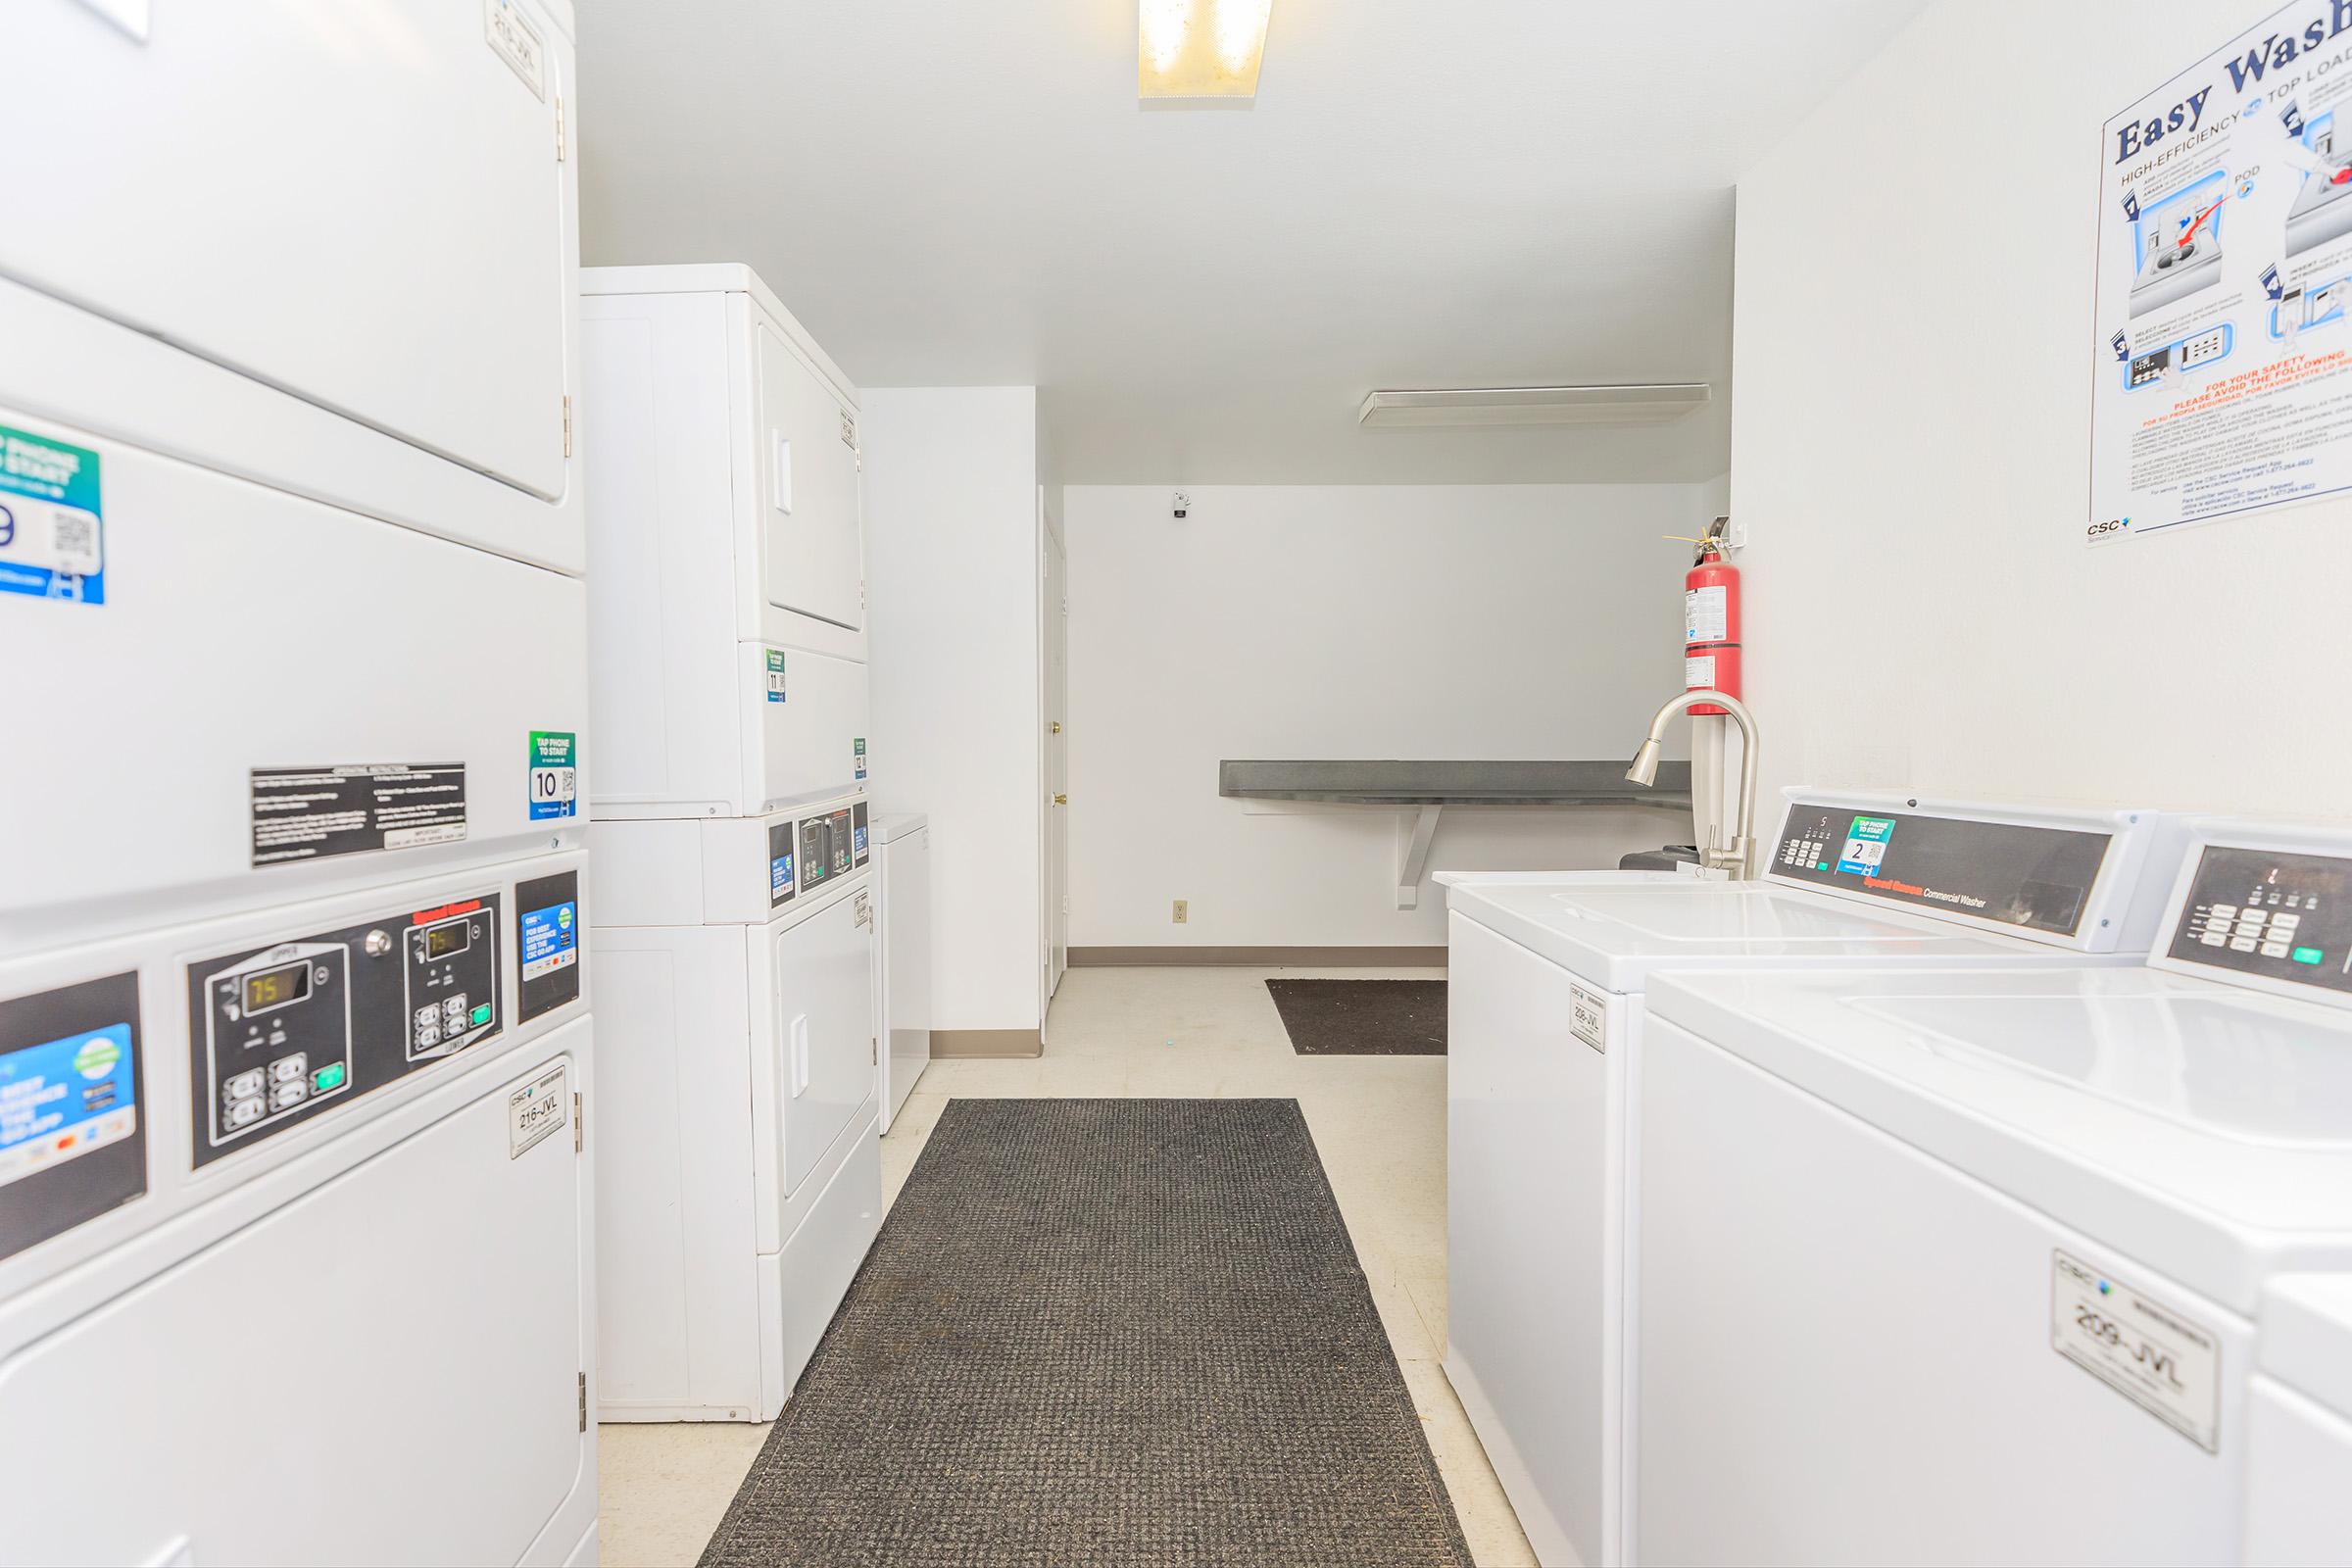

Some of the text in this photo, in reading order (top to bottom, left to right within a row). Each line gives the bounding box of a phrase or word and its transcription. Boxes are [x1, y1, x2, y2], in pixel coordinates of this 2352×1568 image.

[2268, 76, 2300, 103] TOP
[2115, 85, 2212, 165] Easy
[2122, 111, 2239, 186] HIGH-EFFICIENCY
[2234, 165, 2260, 184] POD
[2116, 341, 2127, 355] 3
[2174, 392, 2211, 411] PLEASE
[2214, 380, 2246, 398] AVOID
[2248, 372, 2270, 387] THE
[2275, 348, 2345, 378] FOLLOWING
[2205, 352, 2305, 392] FOR YOUR SAFETY
[2087, 519, 2120, 536] CSC
[537, 737, 570, 748] TAP PHONE
[539, 747, 549, 756] TO
[537, 772, 556, 797] 10
[1852, 843, 1863, 858] 2
[1923, 887, 1961, 903] Commercial
[1960, 894, 1986, 908] Washer
[526, 929, 557, 944] EXPERIENCE
[519, 1096, 558, 1129] 216-JVL
[2076, 1303, 2185, 1390] 209-JVL
